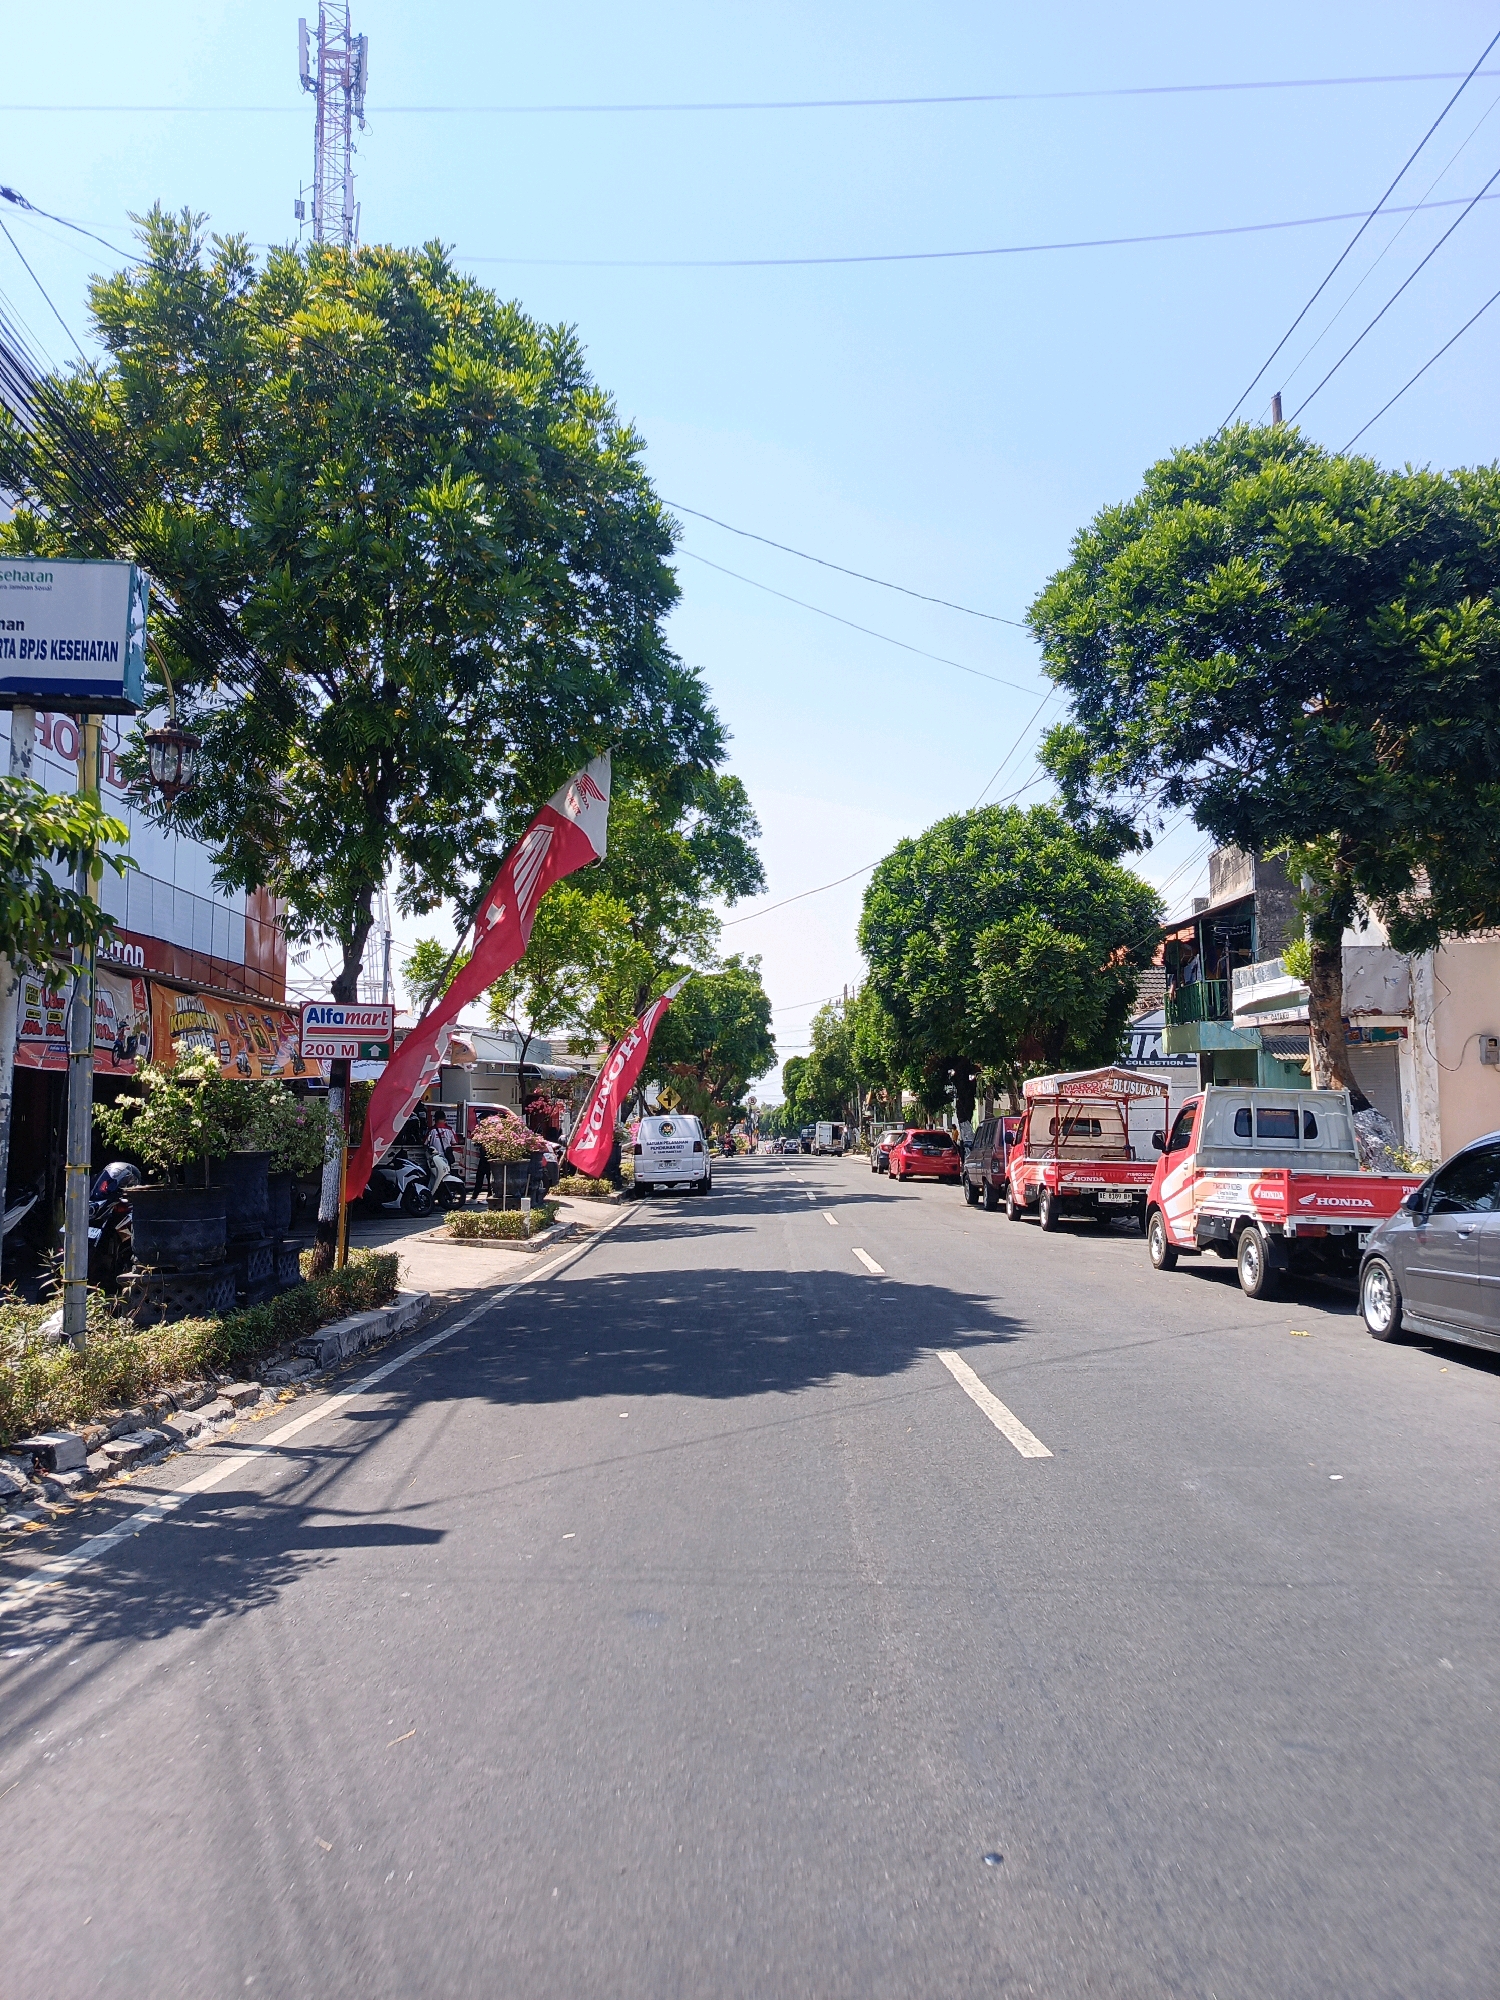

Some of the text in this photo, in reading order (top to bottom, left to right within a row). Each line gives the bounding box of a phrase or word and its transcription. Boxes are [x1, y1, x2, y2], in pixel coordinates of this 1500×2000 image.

[19, 638, 47, 660] BPJS
[51, 639, 118, 662] KESEHATAN
[306, 1007, 388, 1026] Alfamart
[304, 1044, 355, 1056] 200 M
[575, 1029, 642, 1150] HONDA
[1112, 1078, 1162, 1096] BLUSUKAN
[1261, 1190, 1285, 1200] HONDA
[1316, 1197, 1374, 1207] HONDA
